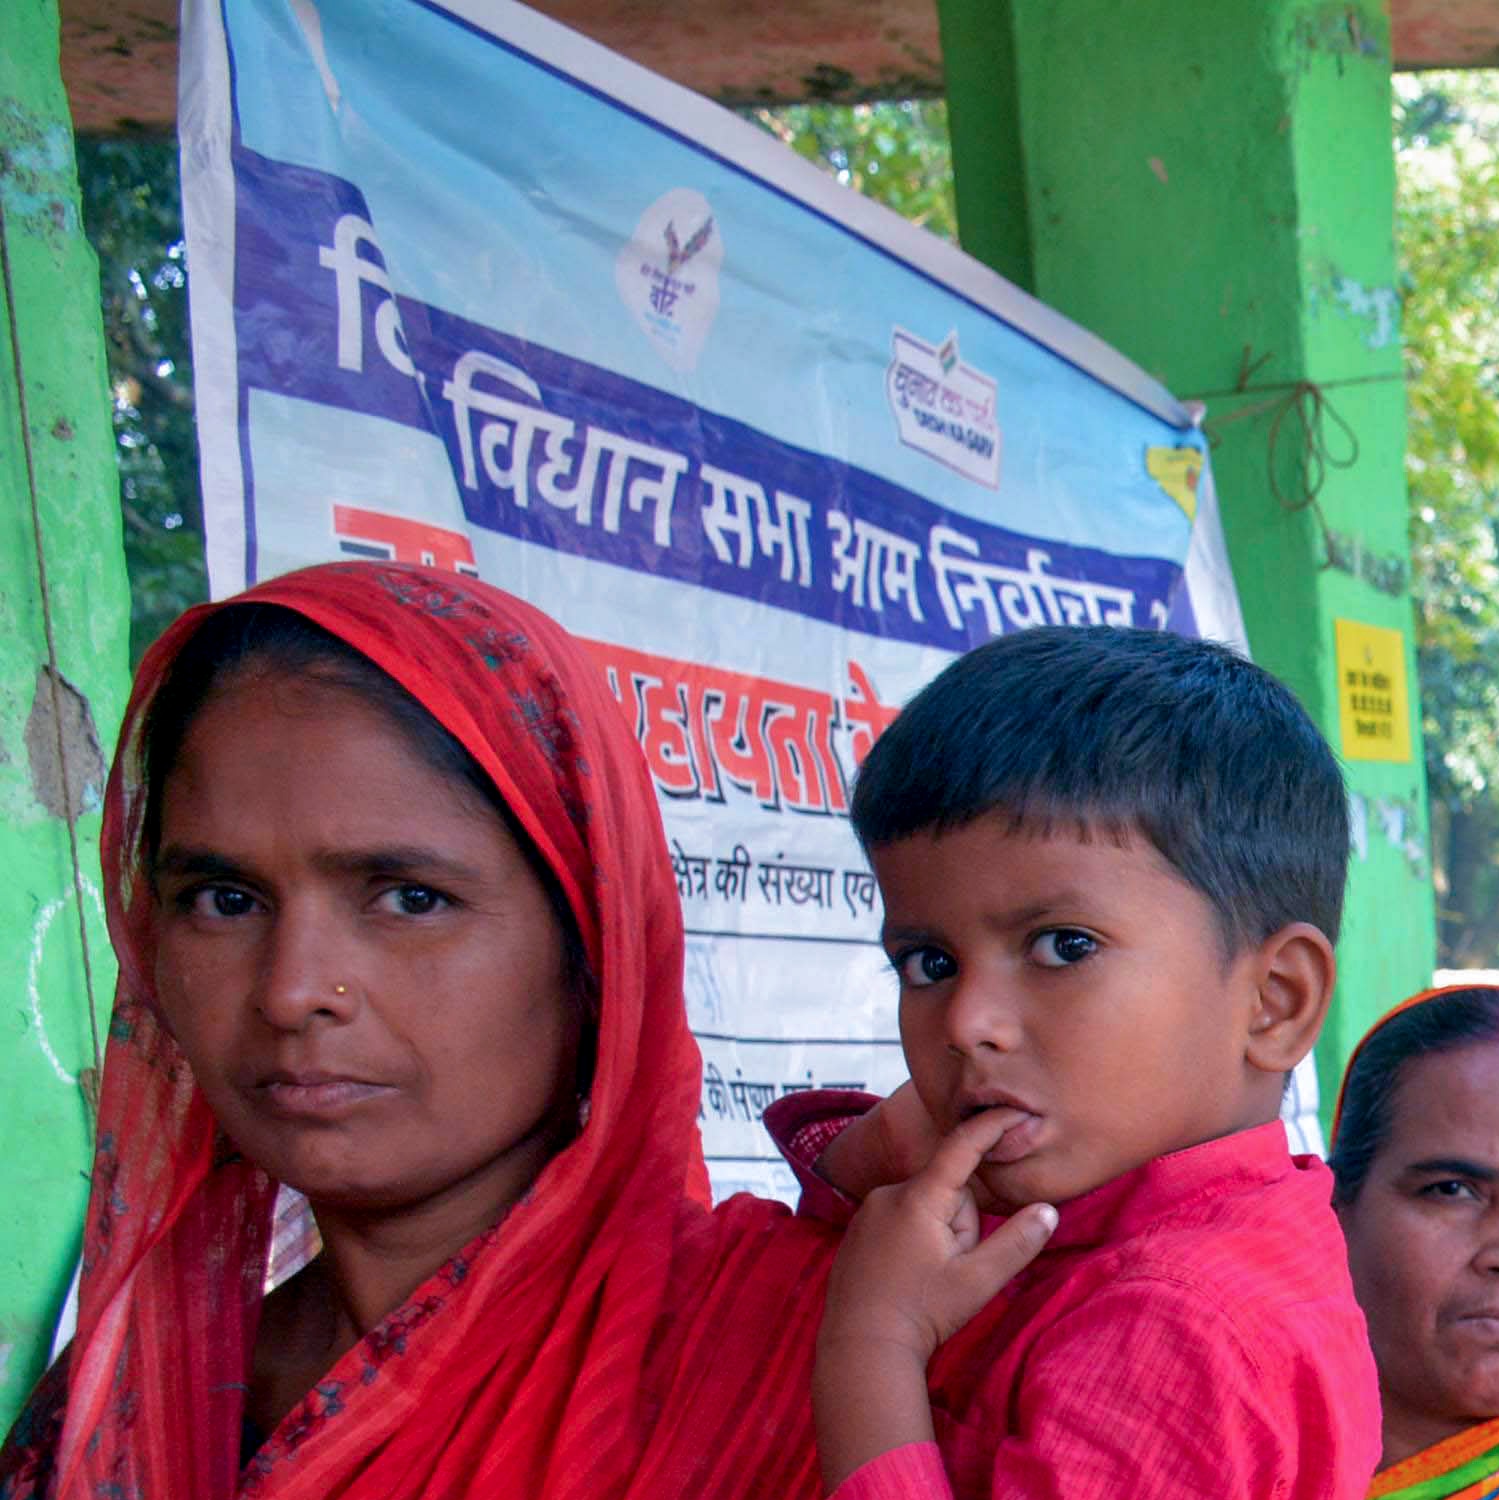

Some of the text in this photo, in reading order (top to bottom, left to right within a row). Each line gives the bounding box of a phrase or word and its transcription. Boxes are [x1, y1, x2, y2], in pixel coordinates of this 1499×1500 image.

[442, 350, 688, 548] विधान
[700, 463, 812, 587] सभा
[827, 510, 926, 622] आम
[572, 633, 850, 815] हायता
[715, 844, 751, 903] की
[759, 851, 834, 909] संख्या
